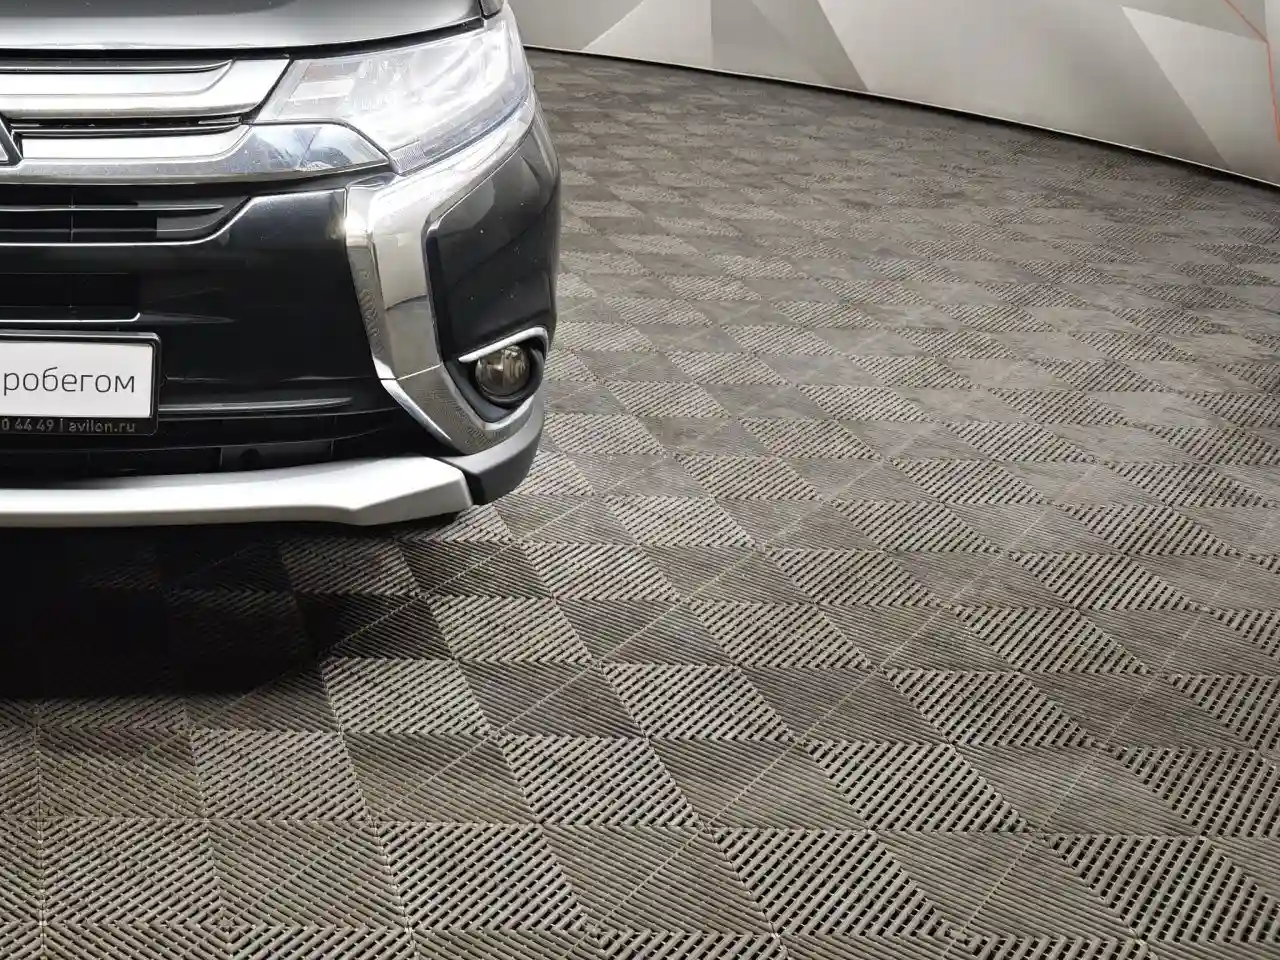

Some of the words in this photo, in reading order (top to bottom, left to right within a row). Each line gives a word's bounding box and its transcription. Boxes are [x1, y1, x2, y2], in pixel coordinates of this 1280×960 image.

[14, 418, 33, 432] 44
[36, 419, 55, 432] 49
[68, 419, 136, 433] avilon.ru
